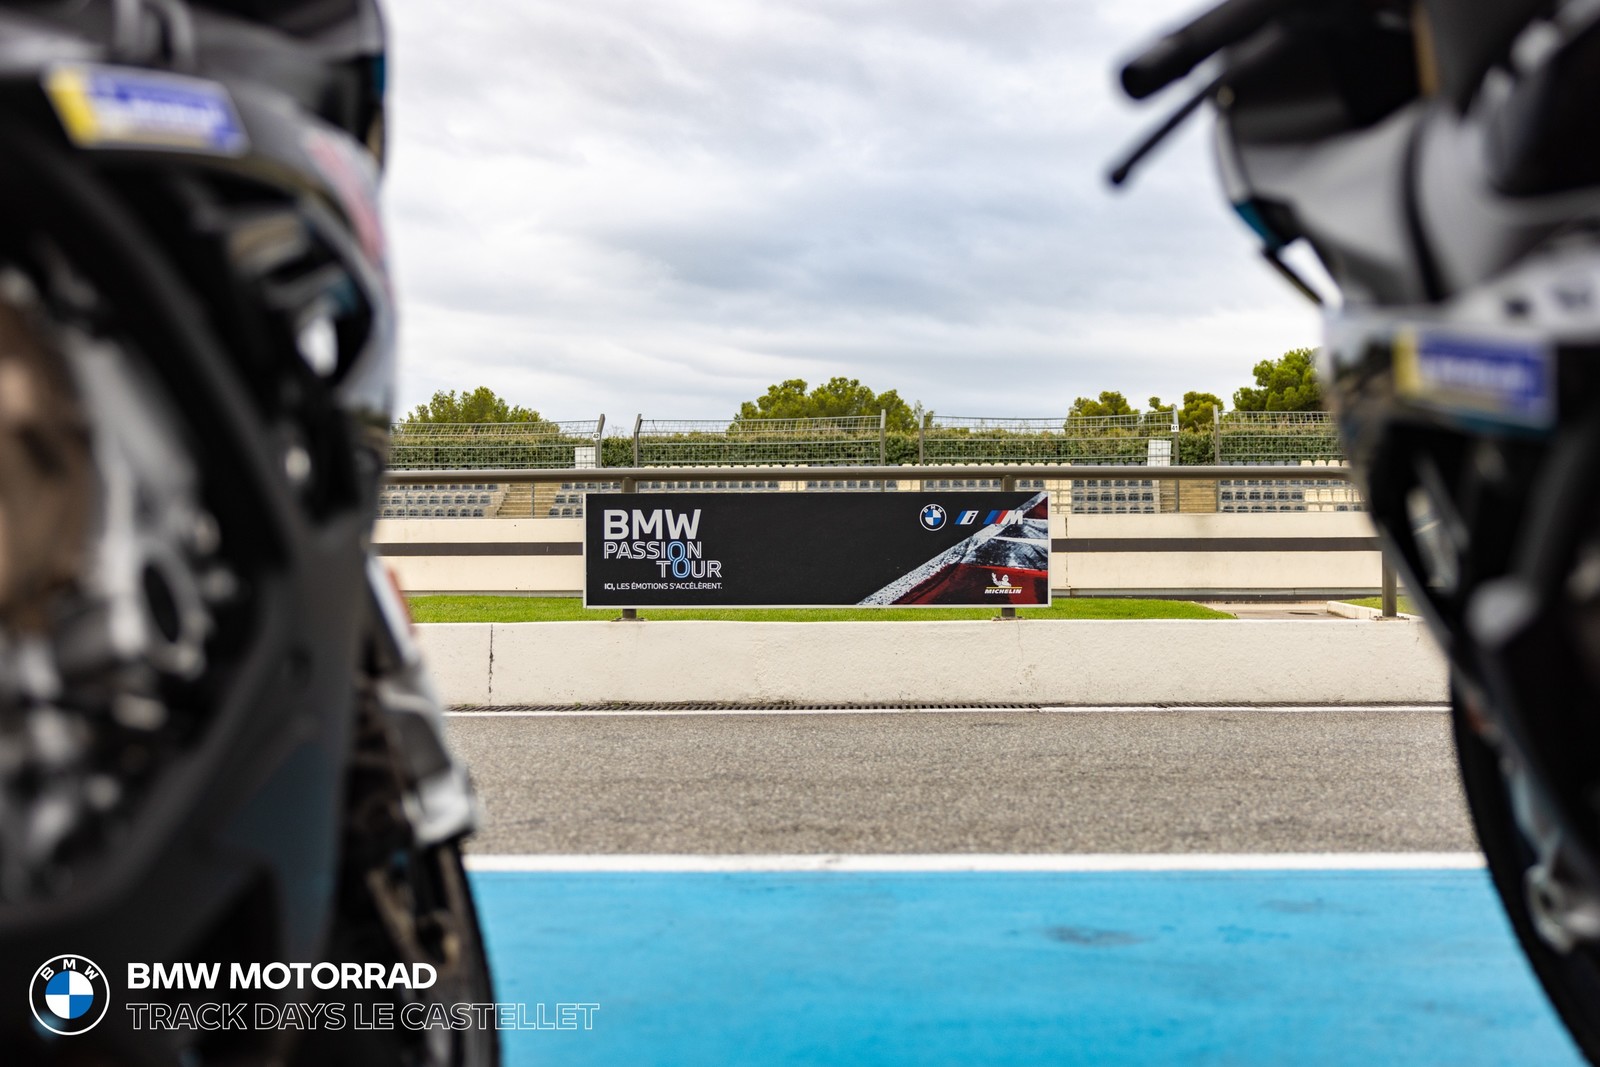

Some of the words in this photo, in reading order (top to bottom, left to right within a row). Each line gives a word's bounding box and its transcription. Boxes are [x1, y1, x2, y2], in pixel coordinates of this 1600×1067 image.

[604, 509, 701, 539] BMW
[604, 541, 702, 561] PASSION
[656, 559, 722, 578] TOUR
[604, 583, 615, 591] ICI,
[631, 582, 668, 590] ÉMOTIONS
[669, 581, 723, 590] S'ACCÉLÈRENT.
